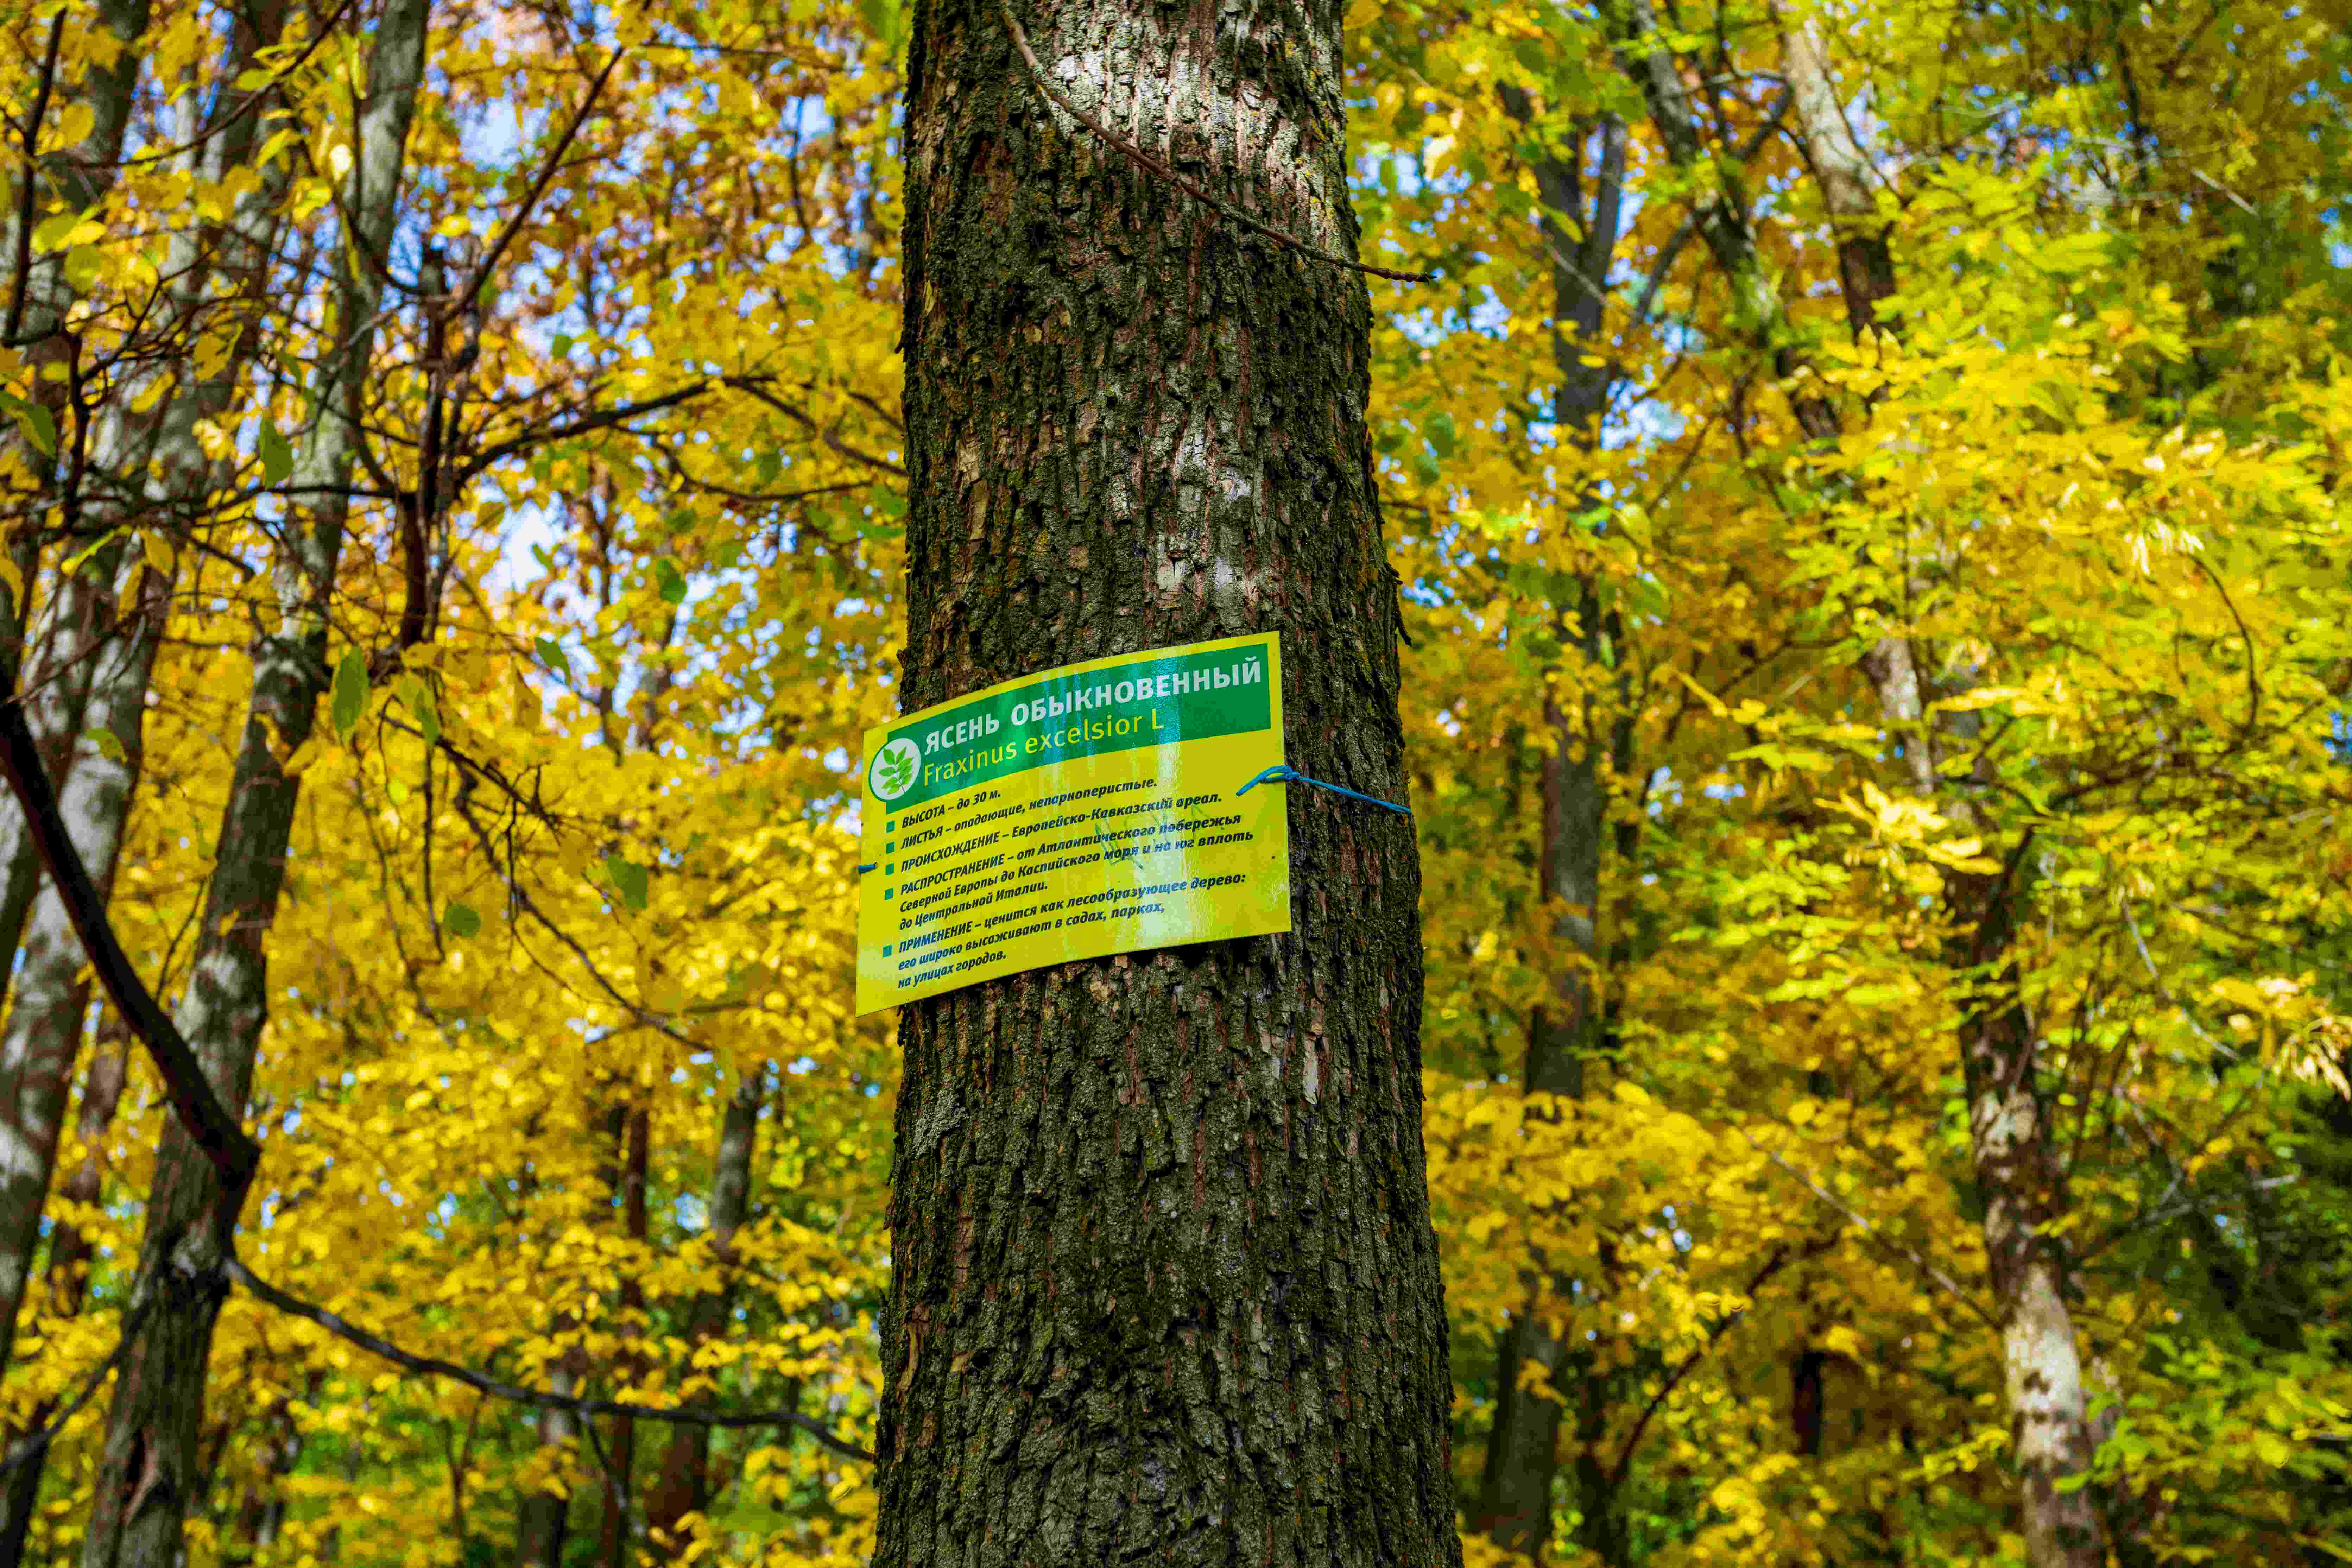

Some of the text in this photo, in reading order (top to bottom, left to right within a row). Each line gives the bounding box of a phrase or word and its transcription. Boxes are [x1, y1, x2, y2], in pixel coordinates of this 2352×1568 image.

[925, 656, 1261, 755] ЯСЕНЬ ОБЫКНОВЕННЫЙ
[924, 709, 1164, 786] Fraxinus excelsior L
[901, 826, 943, 849] ЛИСТЬЯ
[954, 804, 1025, 832] опадающие,
[1029, 779, 1157, 810] непарноперистые.
[901, 831, 1000, 873] ПРОИСХОЖДЕНИЕ
[1012, 797, 1172, 838] Европейско-Кавказский
[1176, 794, 1221, 810] ареал.
[902, 804, 945, 828] ВЫСОТА
[957, 798, 970, 809] до
[973, 791, 986, 805] 30
[989, 790, 1001, 800] м.
[900, 832, 1253, 912] Северной Европы до Каспийского моря и на юг вплоть
[901, 853, 1005, 896] РАСПРОСТРАНЕНИЕ
[1017, 848, 1035, 860] от
[1038, 826, 1155, 855] Атлантического
[1159, 815, 1241, 834] побережья
[898, 902, 1164, 970] его широко высаживают в садах, парках,
[899, 881, 1048, 930] до Центральной Италии.
[899, 921, 973, 953] ПРИМЕНЕНИЕ
[984, 906, 1037, 929] ценится
[1040, 900, 1064, 913] как
[1067, 881, 1187, 908] лесообразующее
[1191, 874, 1246, 890] дерево:
[898, 951, 1006, 988] на улицах городов.
